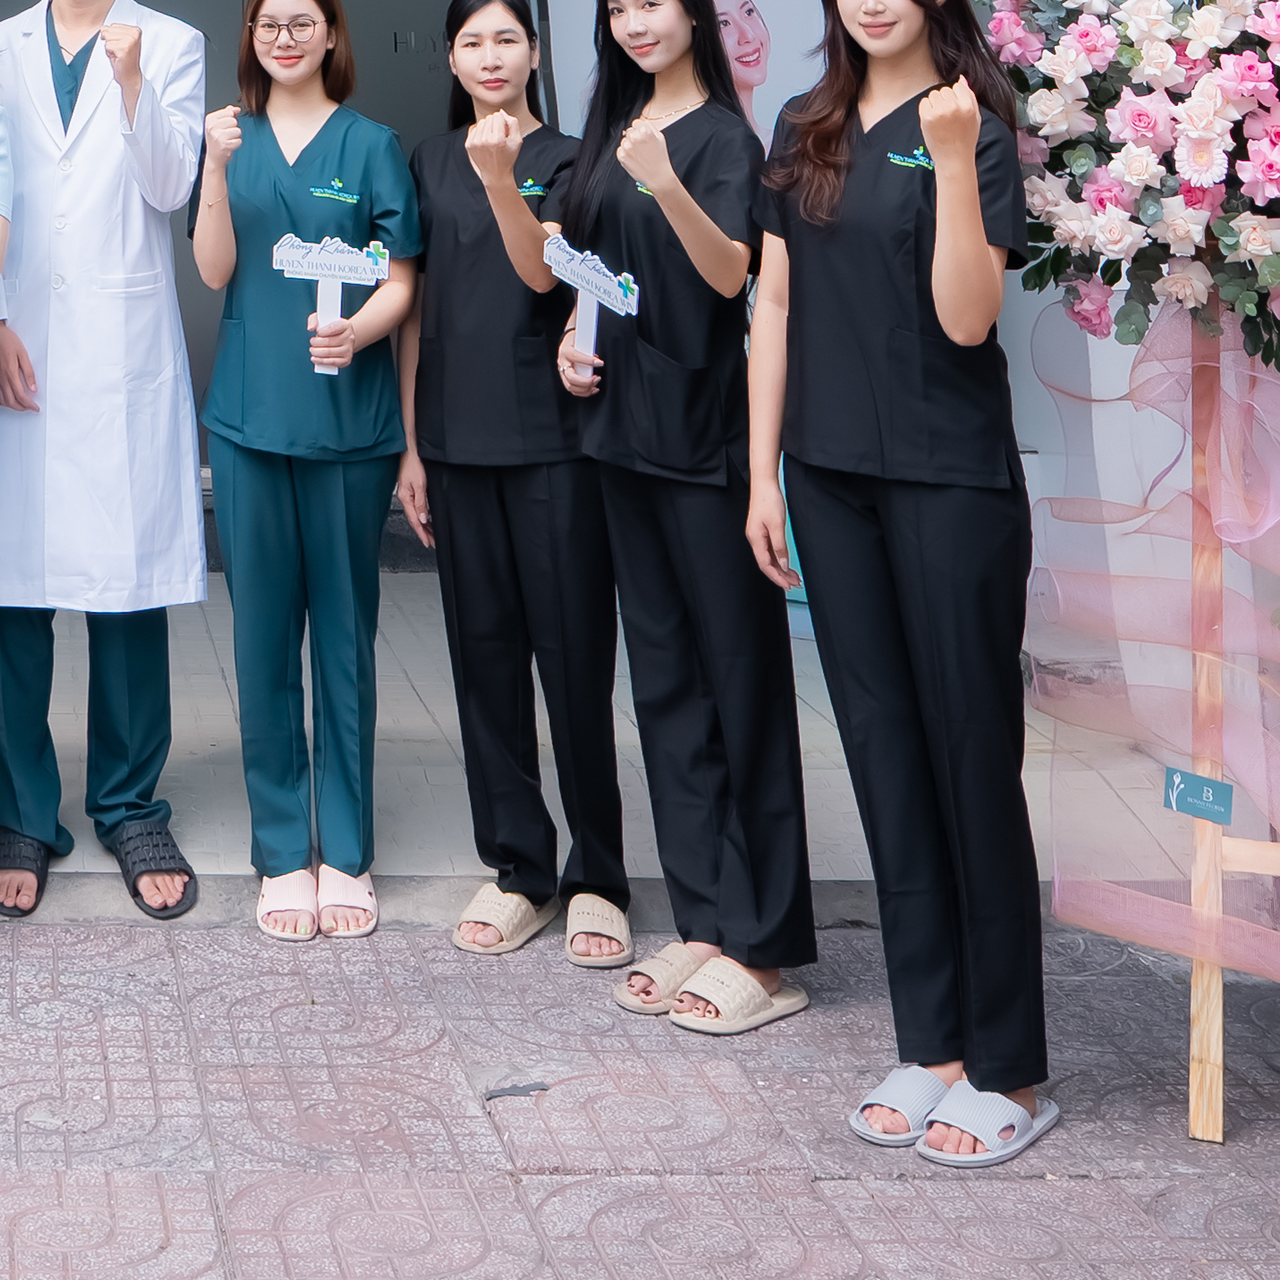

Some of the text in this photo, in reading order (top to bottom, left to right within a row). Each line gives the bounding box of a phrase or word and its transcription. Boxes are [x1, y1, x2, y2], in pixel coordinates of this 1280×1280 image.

[276, 235, 363, 260] Phòng Khám
[546, 236, 616, 282] Phòng Khám
[306, 260, 336, 272] THANH
[338, 264, 368, 276] KOREA
[369, 266, 388, 278] WIN
